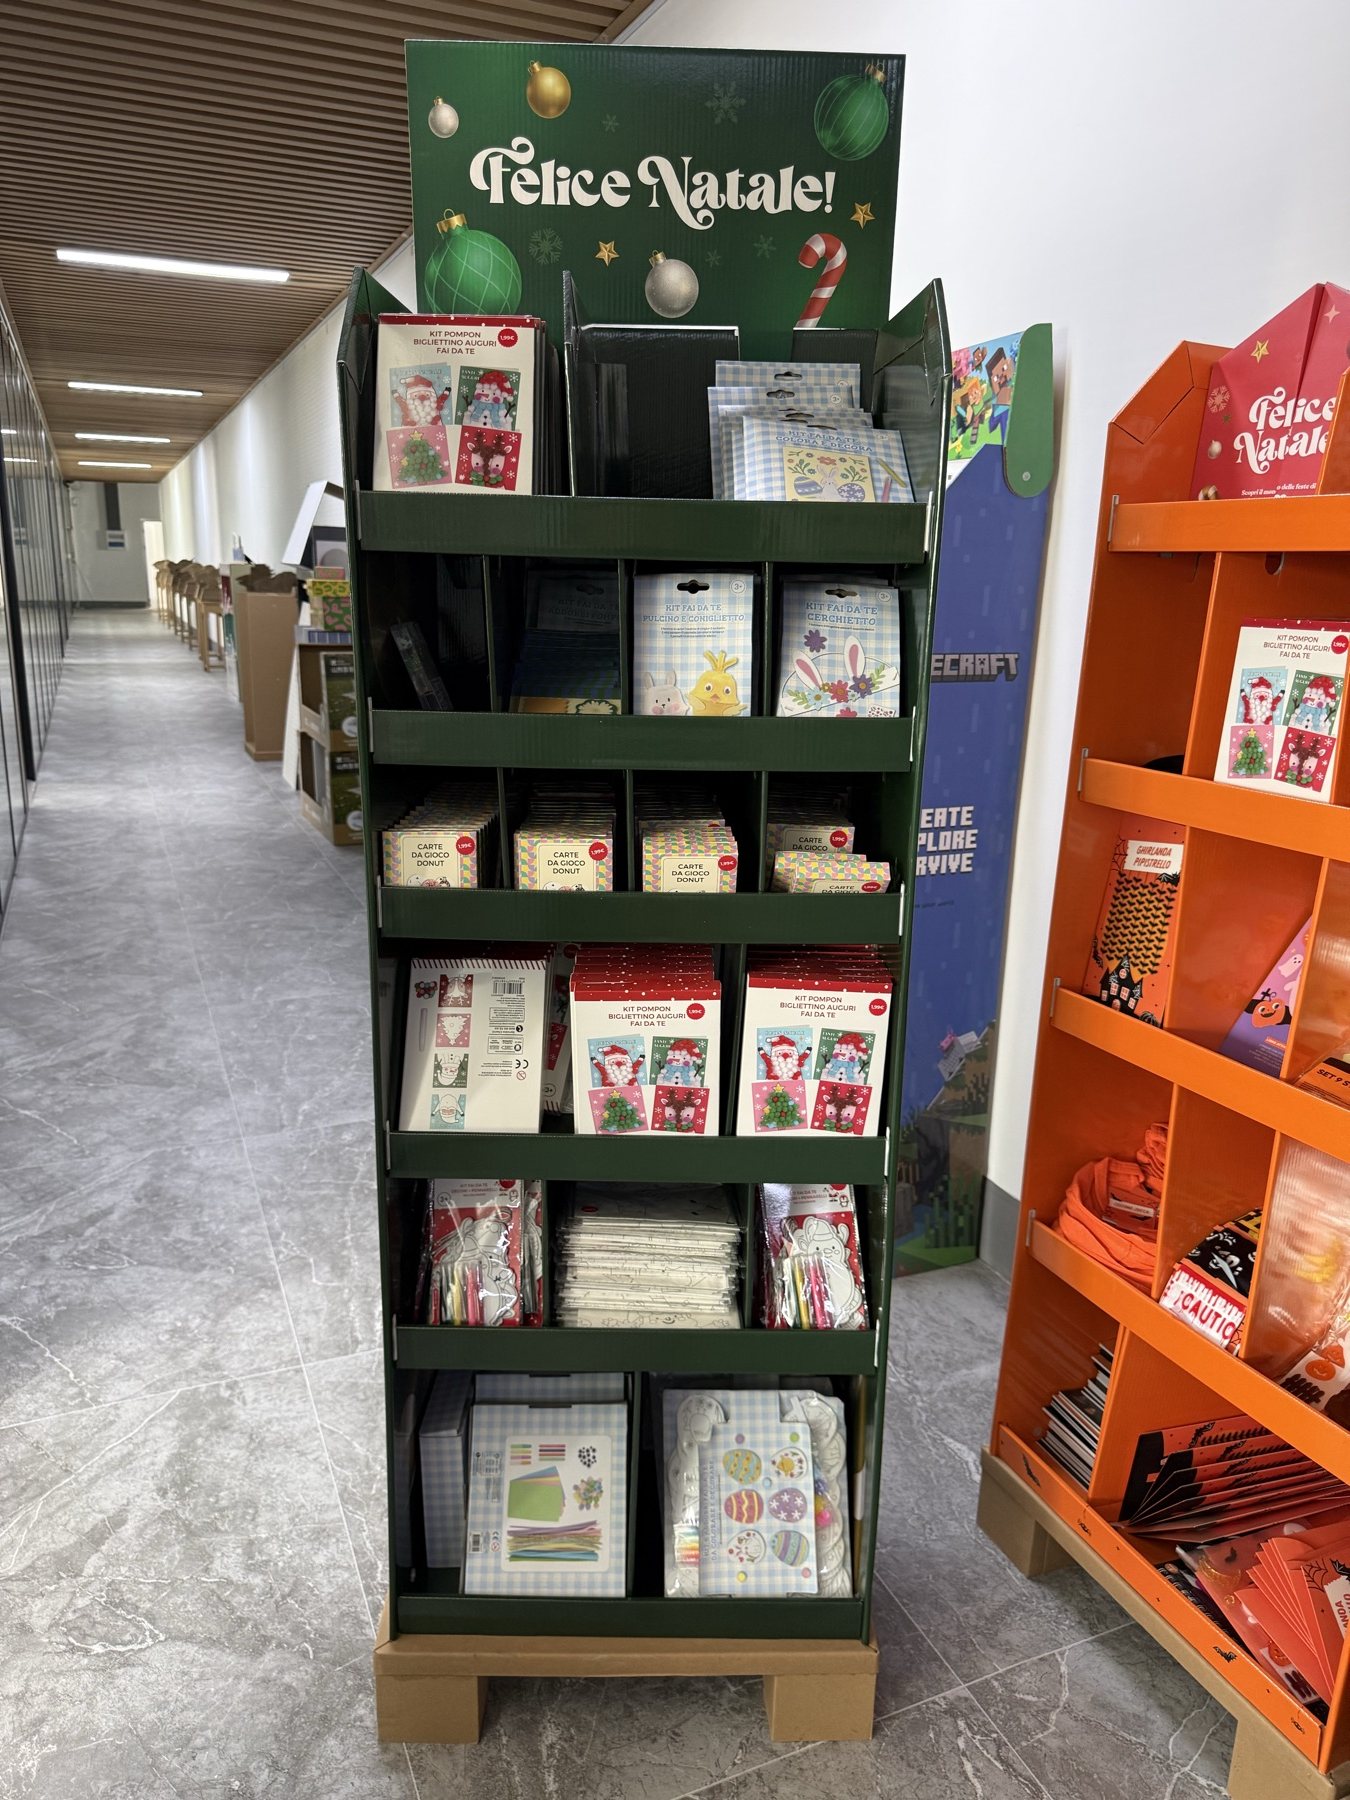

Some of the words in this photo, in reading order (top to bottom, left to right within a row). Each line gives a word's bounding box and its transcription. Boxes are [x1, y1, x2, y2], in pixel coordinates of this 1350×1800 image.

[469, 136, 631, 207] Felice
[637, 156, 837, 230] Natale!
[430, 330, 442, 338] KIT
[414, 338, 464, 346] BIGLIETTINO
[810, 432, 828, 440] FAI
[776, 436, 818, 445] COLORA
[830, 442, 872, 452] DECORA
[666, 604, 680, 612] KIT
[682, 604, 696, 612] FAI
[806, 602, 825, 610] KIT
[826, 604, 844, 612] FAI
[846, 606, 861, 614] DA
[864, 606, 878, 615] TE
[688, 614, 745, 622] CONIGLIETTO
[807, 612, 876, 626] CERCHIETTO
[1276, 634, 1288, 642] KIT
[1288, 635, 1319, 643] POMPON
[1264, 642, 1302, 651] BIGLIETTINO
[1303, 644, 1330, 653] AUGURI
[1302, 652, 1311, 660] TE
[798, 836, 823, 844] CARTE
[804, 844, 828, 852] GIOCO
[1136, 845, 1172, 856] GHIRLANDA
[1132, 857, 1172, 869] PIPISTRELLO
[780, 1002, 826, 1010] BIGLIETTINO
[826, 1004, 856, 1012] AUGURI
[1316, 1068, 1336, 1079] SET
